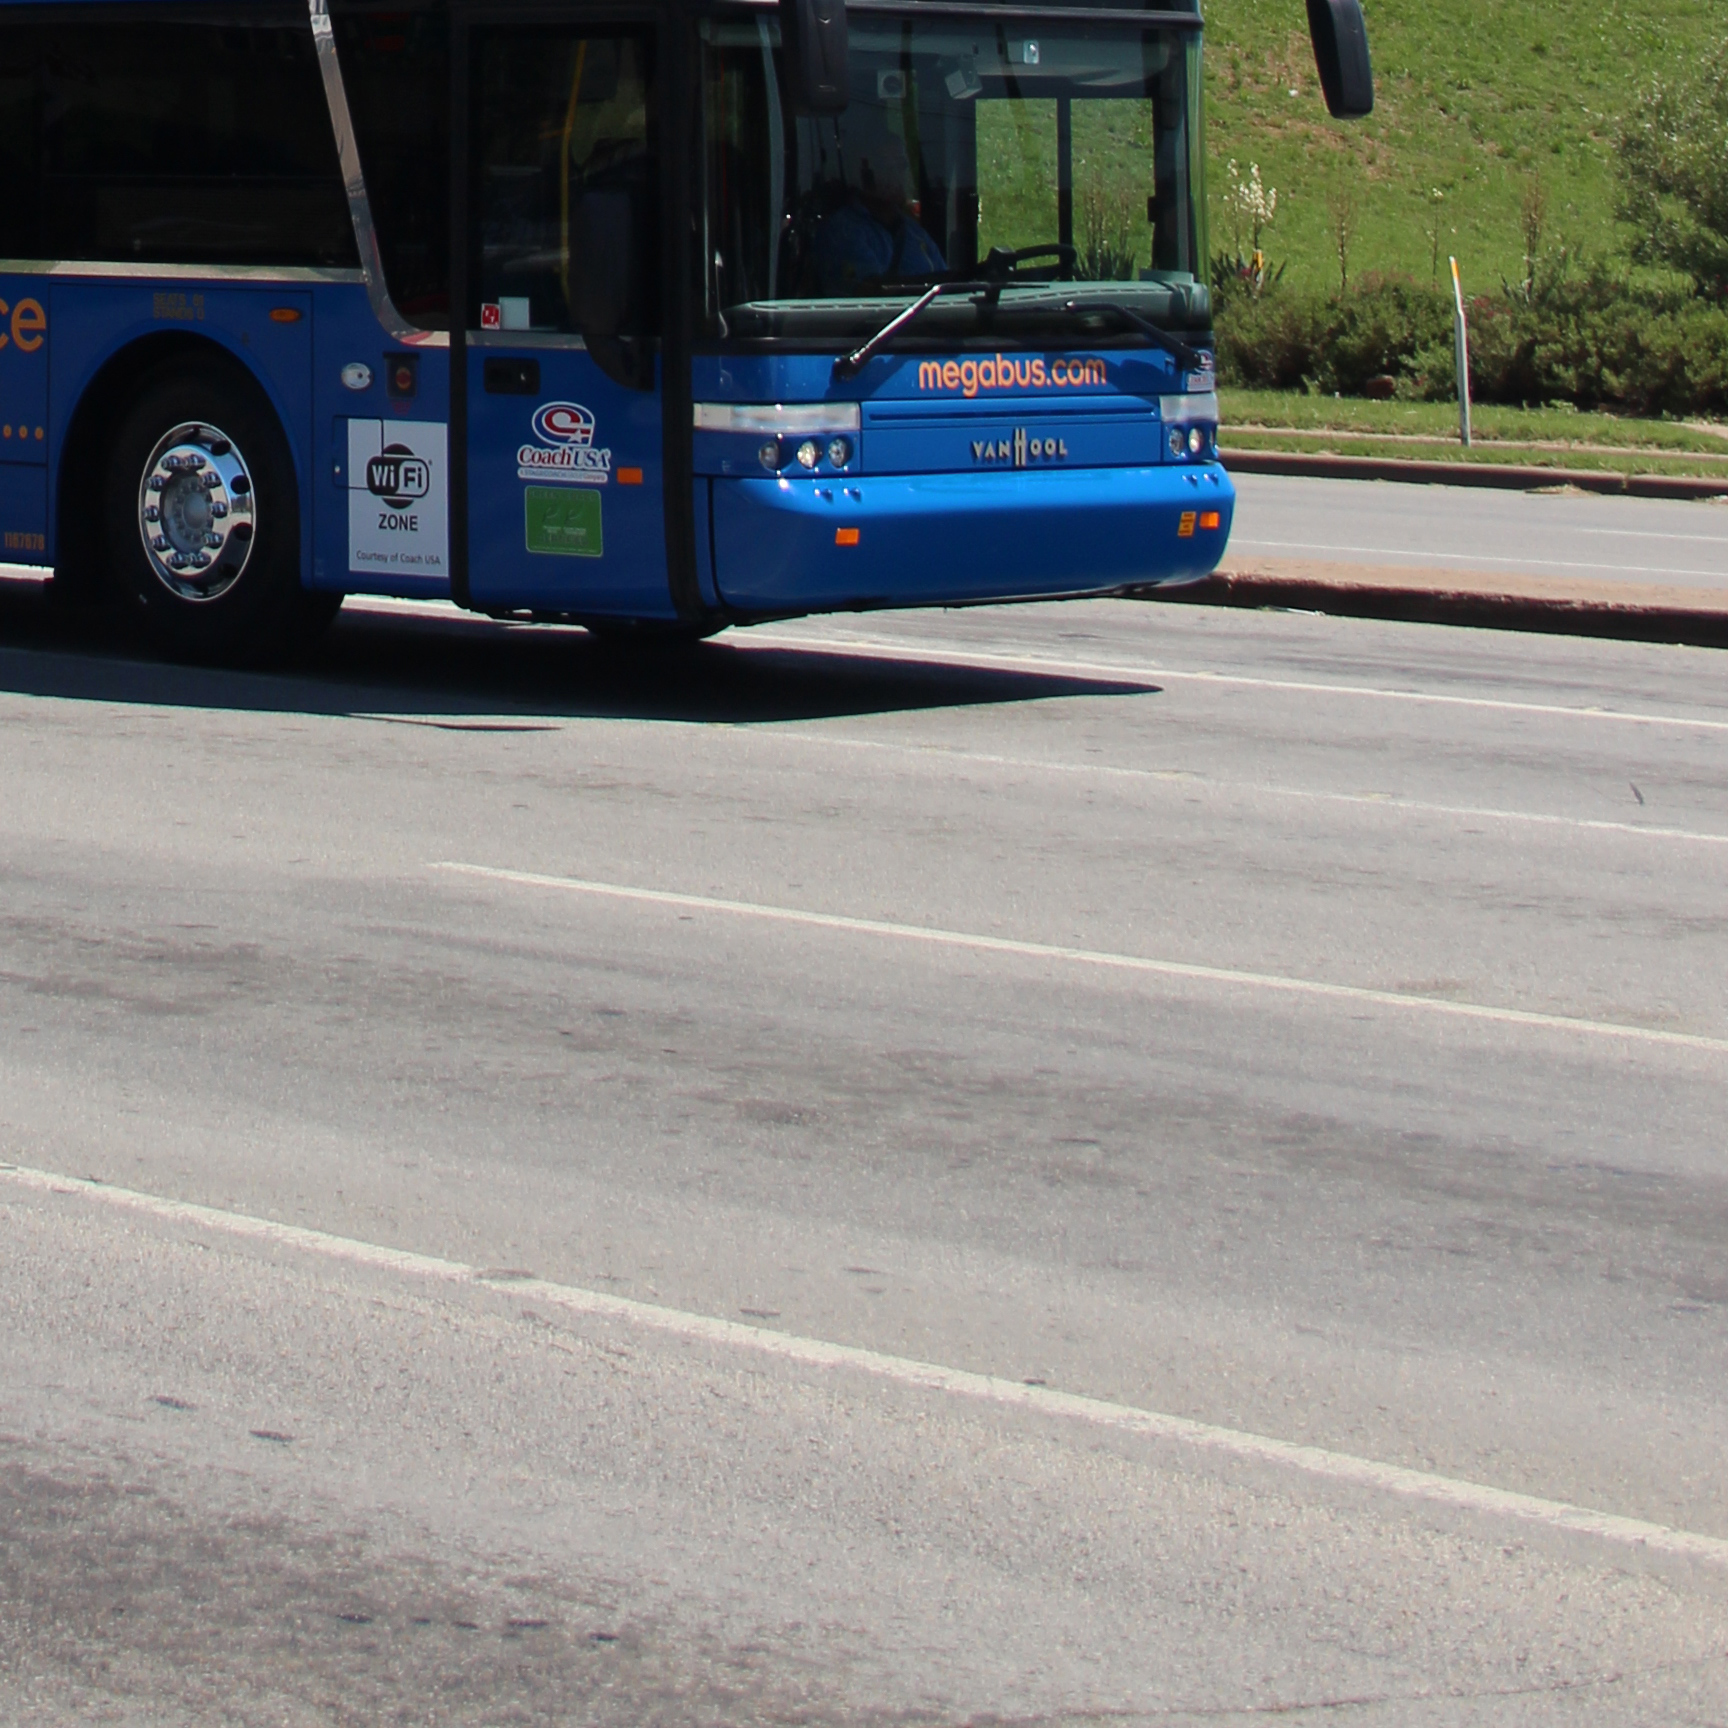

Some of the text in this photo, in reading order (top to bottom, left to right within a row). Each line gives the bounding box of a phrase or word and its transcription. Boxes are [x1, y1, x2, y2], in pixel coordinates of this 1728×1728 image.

[919, 352, 1107, 398] megabus.com
[378, 513, 418, 531] ZONE
[356, 550, 441, 565] Courtesy of Coach USA
